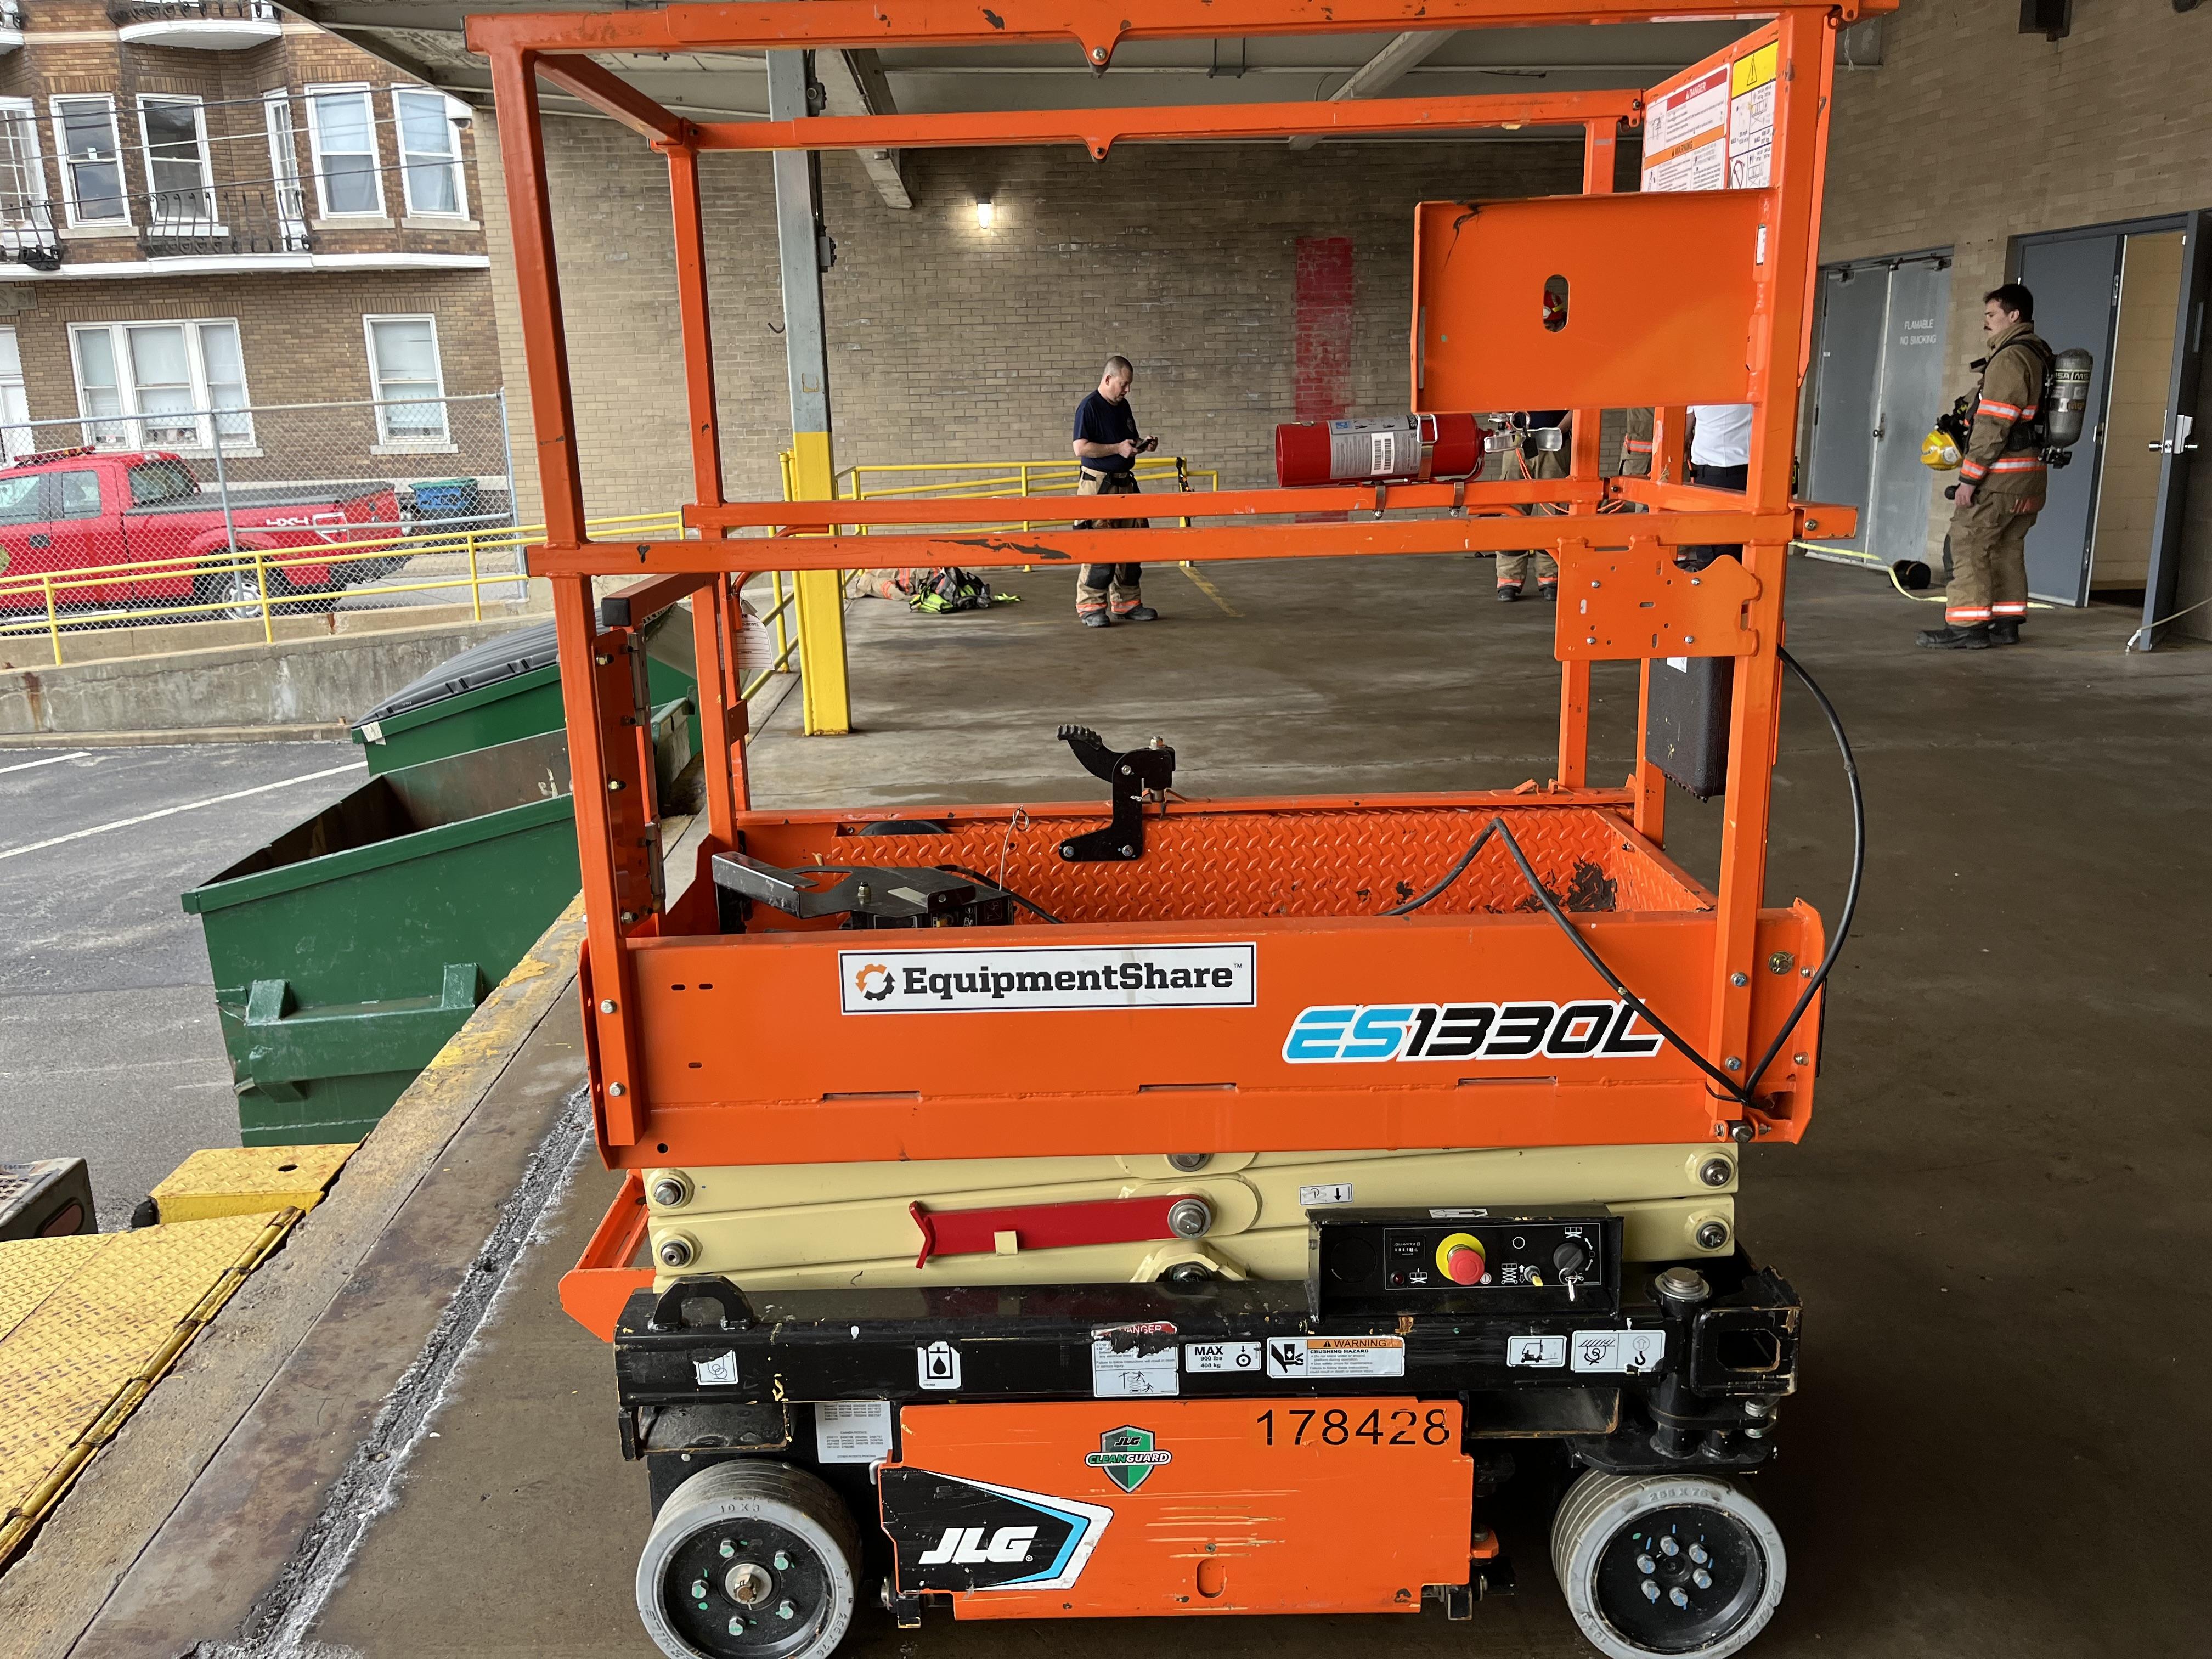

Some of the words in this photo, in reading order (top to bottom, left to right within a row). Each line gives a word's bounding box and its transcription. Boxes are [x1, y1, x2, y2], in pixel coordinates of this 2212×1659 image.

[1689, 82, 1706, 99] DANGER
[1675, 140, 1693, 154] WARNING
[1900, 336, 1909, 345] NO
[1910, 334, 1937, 345] SMOKING
[902, 962, 1233, 1000] EquipmentShare
[1284, 1001, 1663, 1060] ES1330L
[1195, 1346, 1223, 1356] MAX
[1257, 1409, 1450, 1446] 178428
[1114, 1436, 1142, 1447] JLG
[1087, 1453, 1169, 1464] CLEANGUARD
[918, 1526, 1039, 1564] JLG
